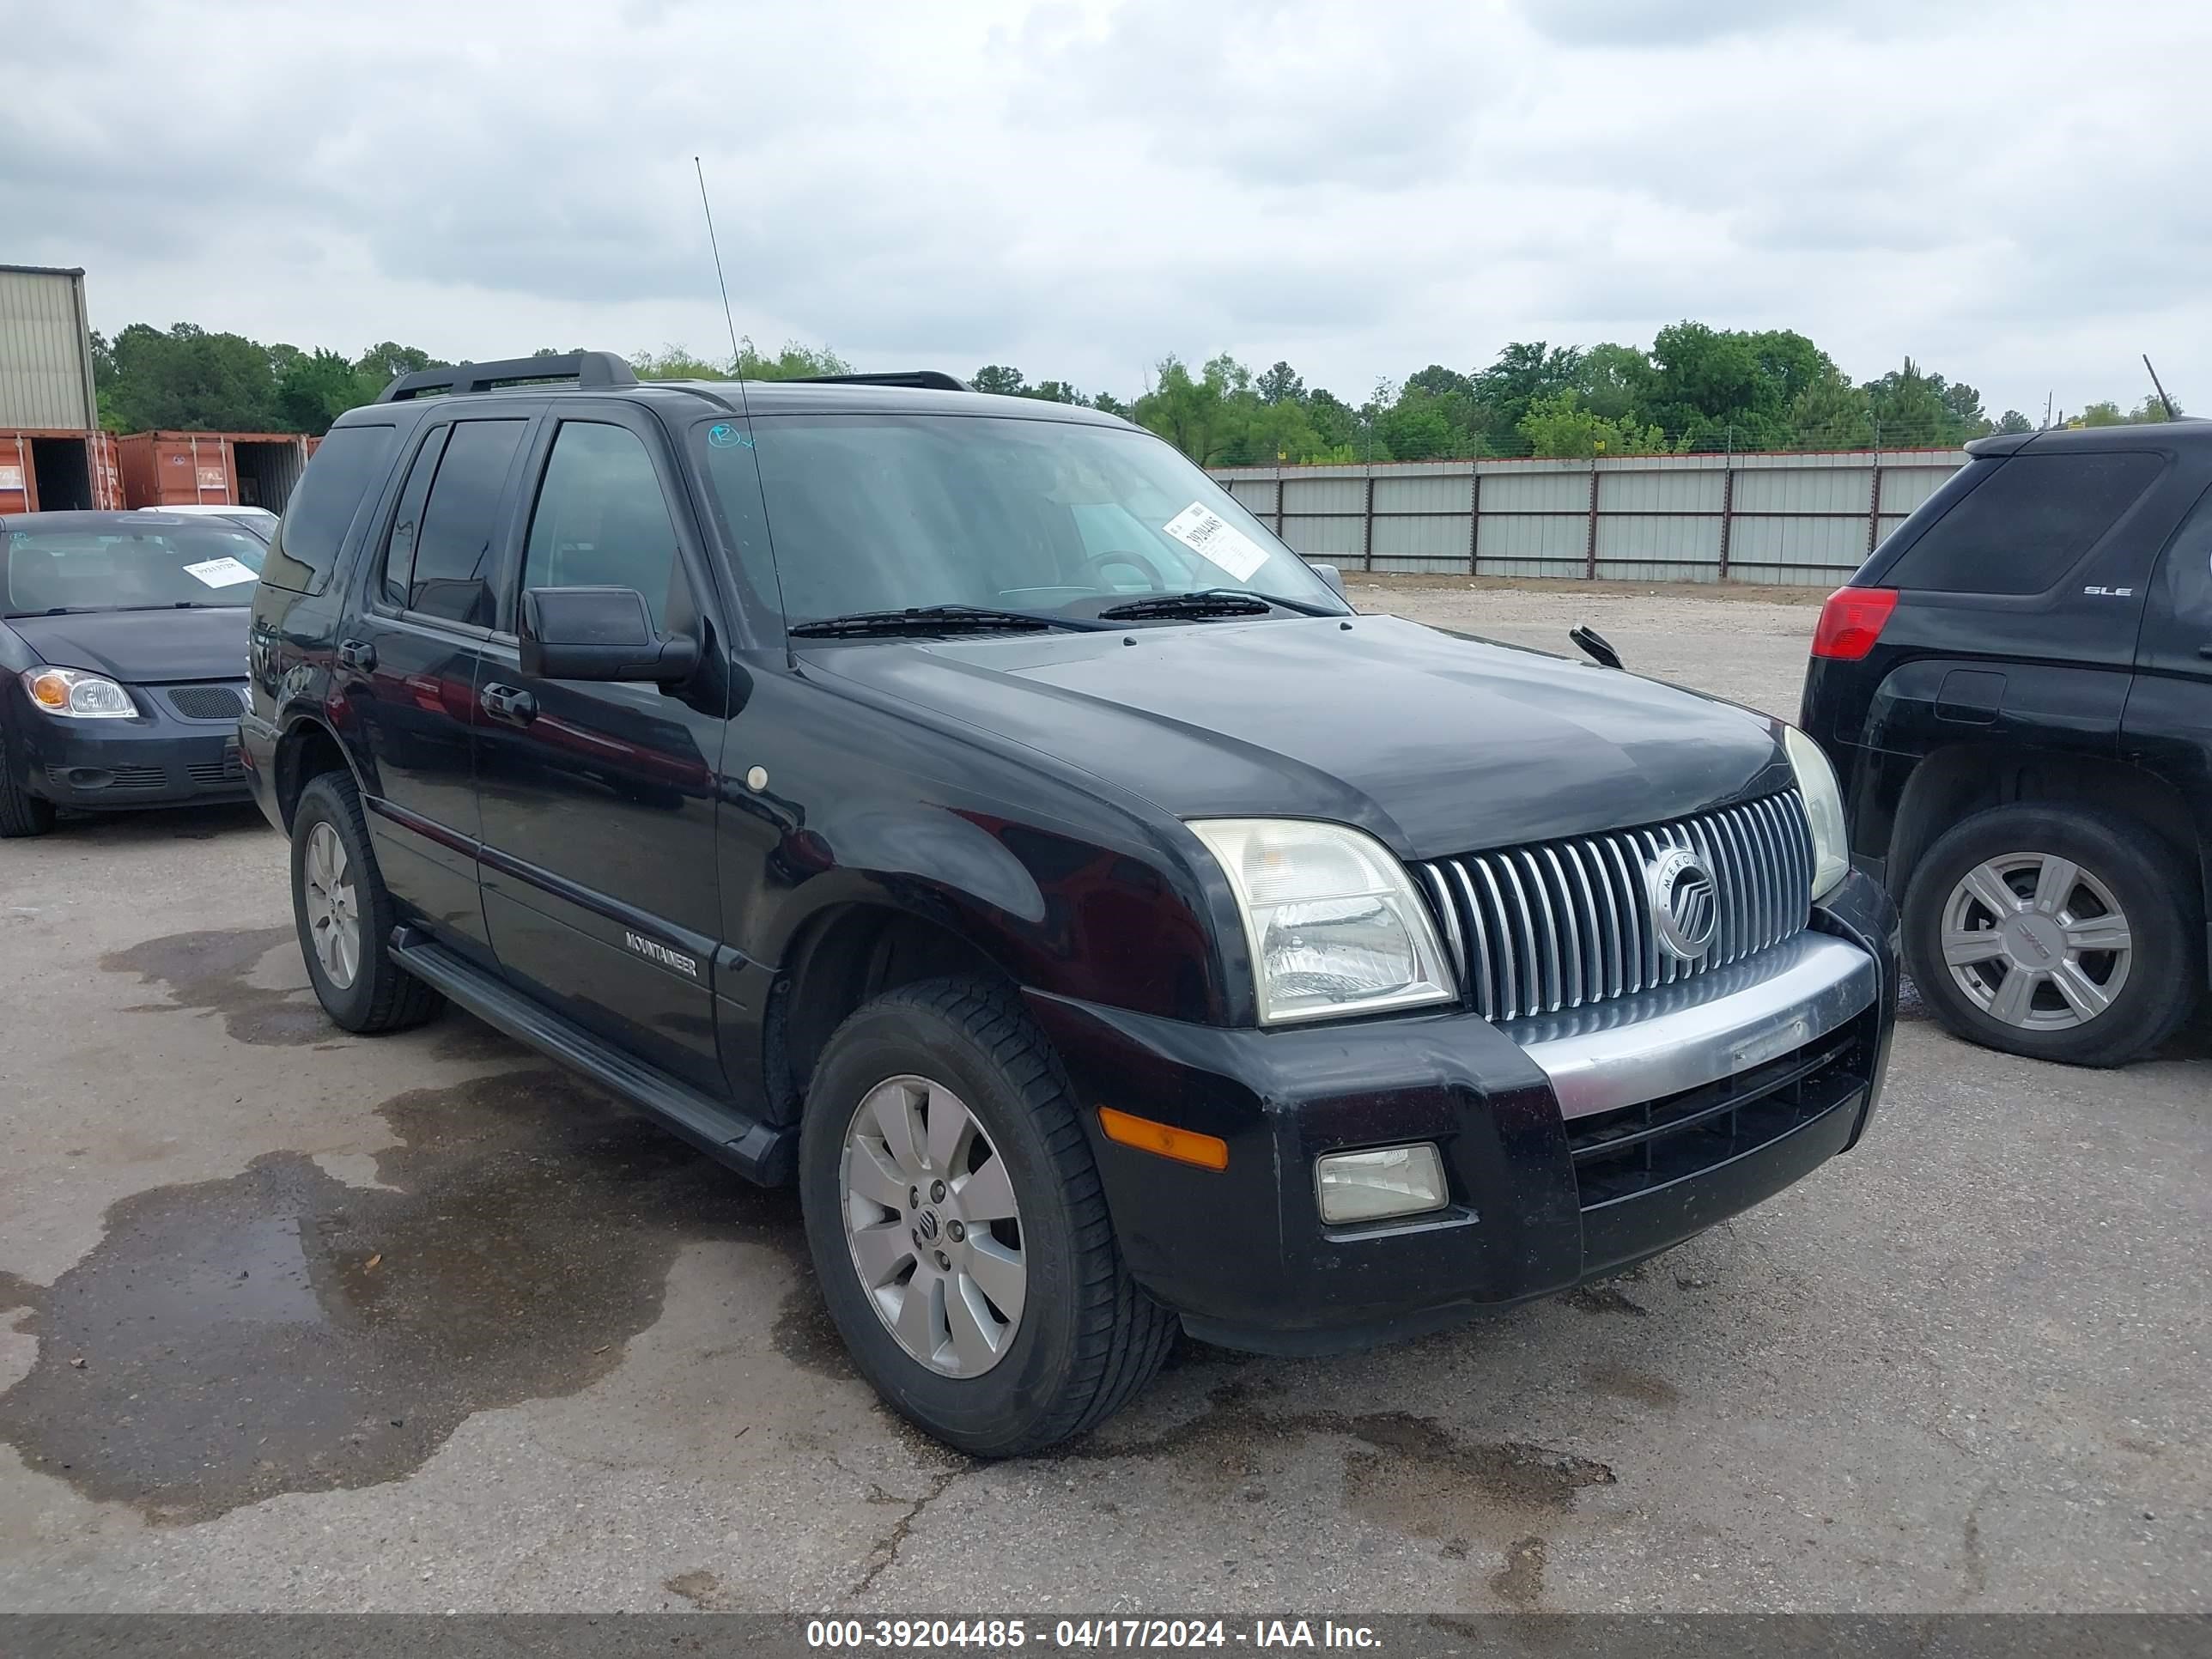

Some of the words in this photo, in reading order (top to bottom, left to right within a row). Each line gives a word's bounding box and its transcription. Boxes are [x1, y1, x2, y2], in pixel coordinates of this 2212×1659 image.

[1185, 516, 1223, 547] 39204485
[2083, 586, 2133, 597] SLE
[625, 932, 698, 977] MOUNTAINEER
